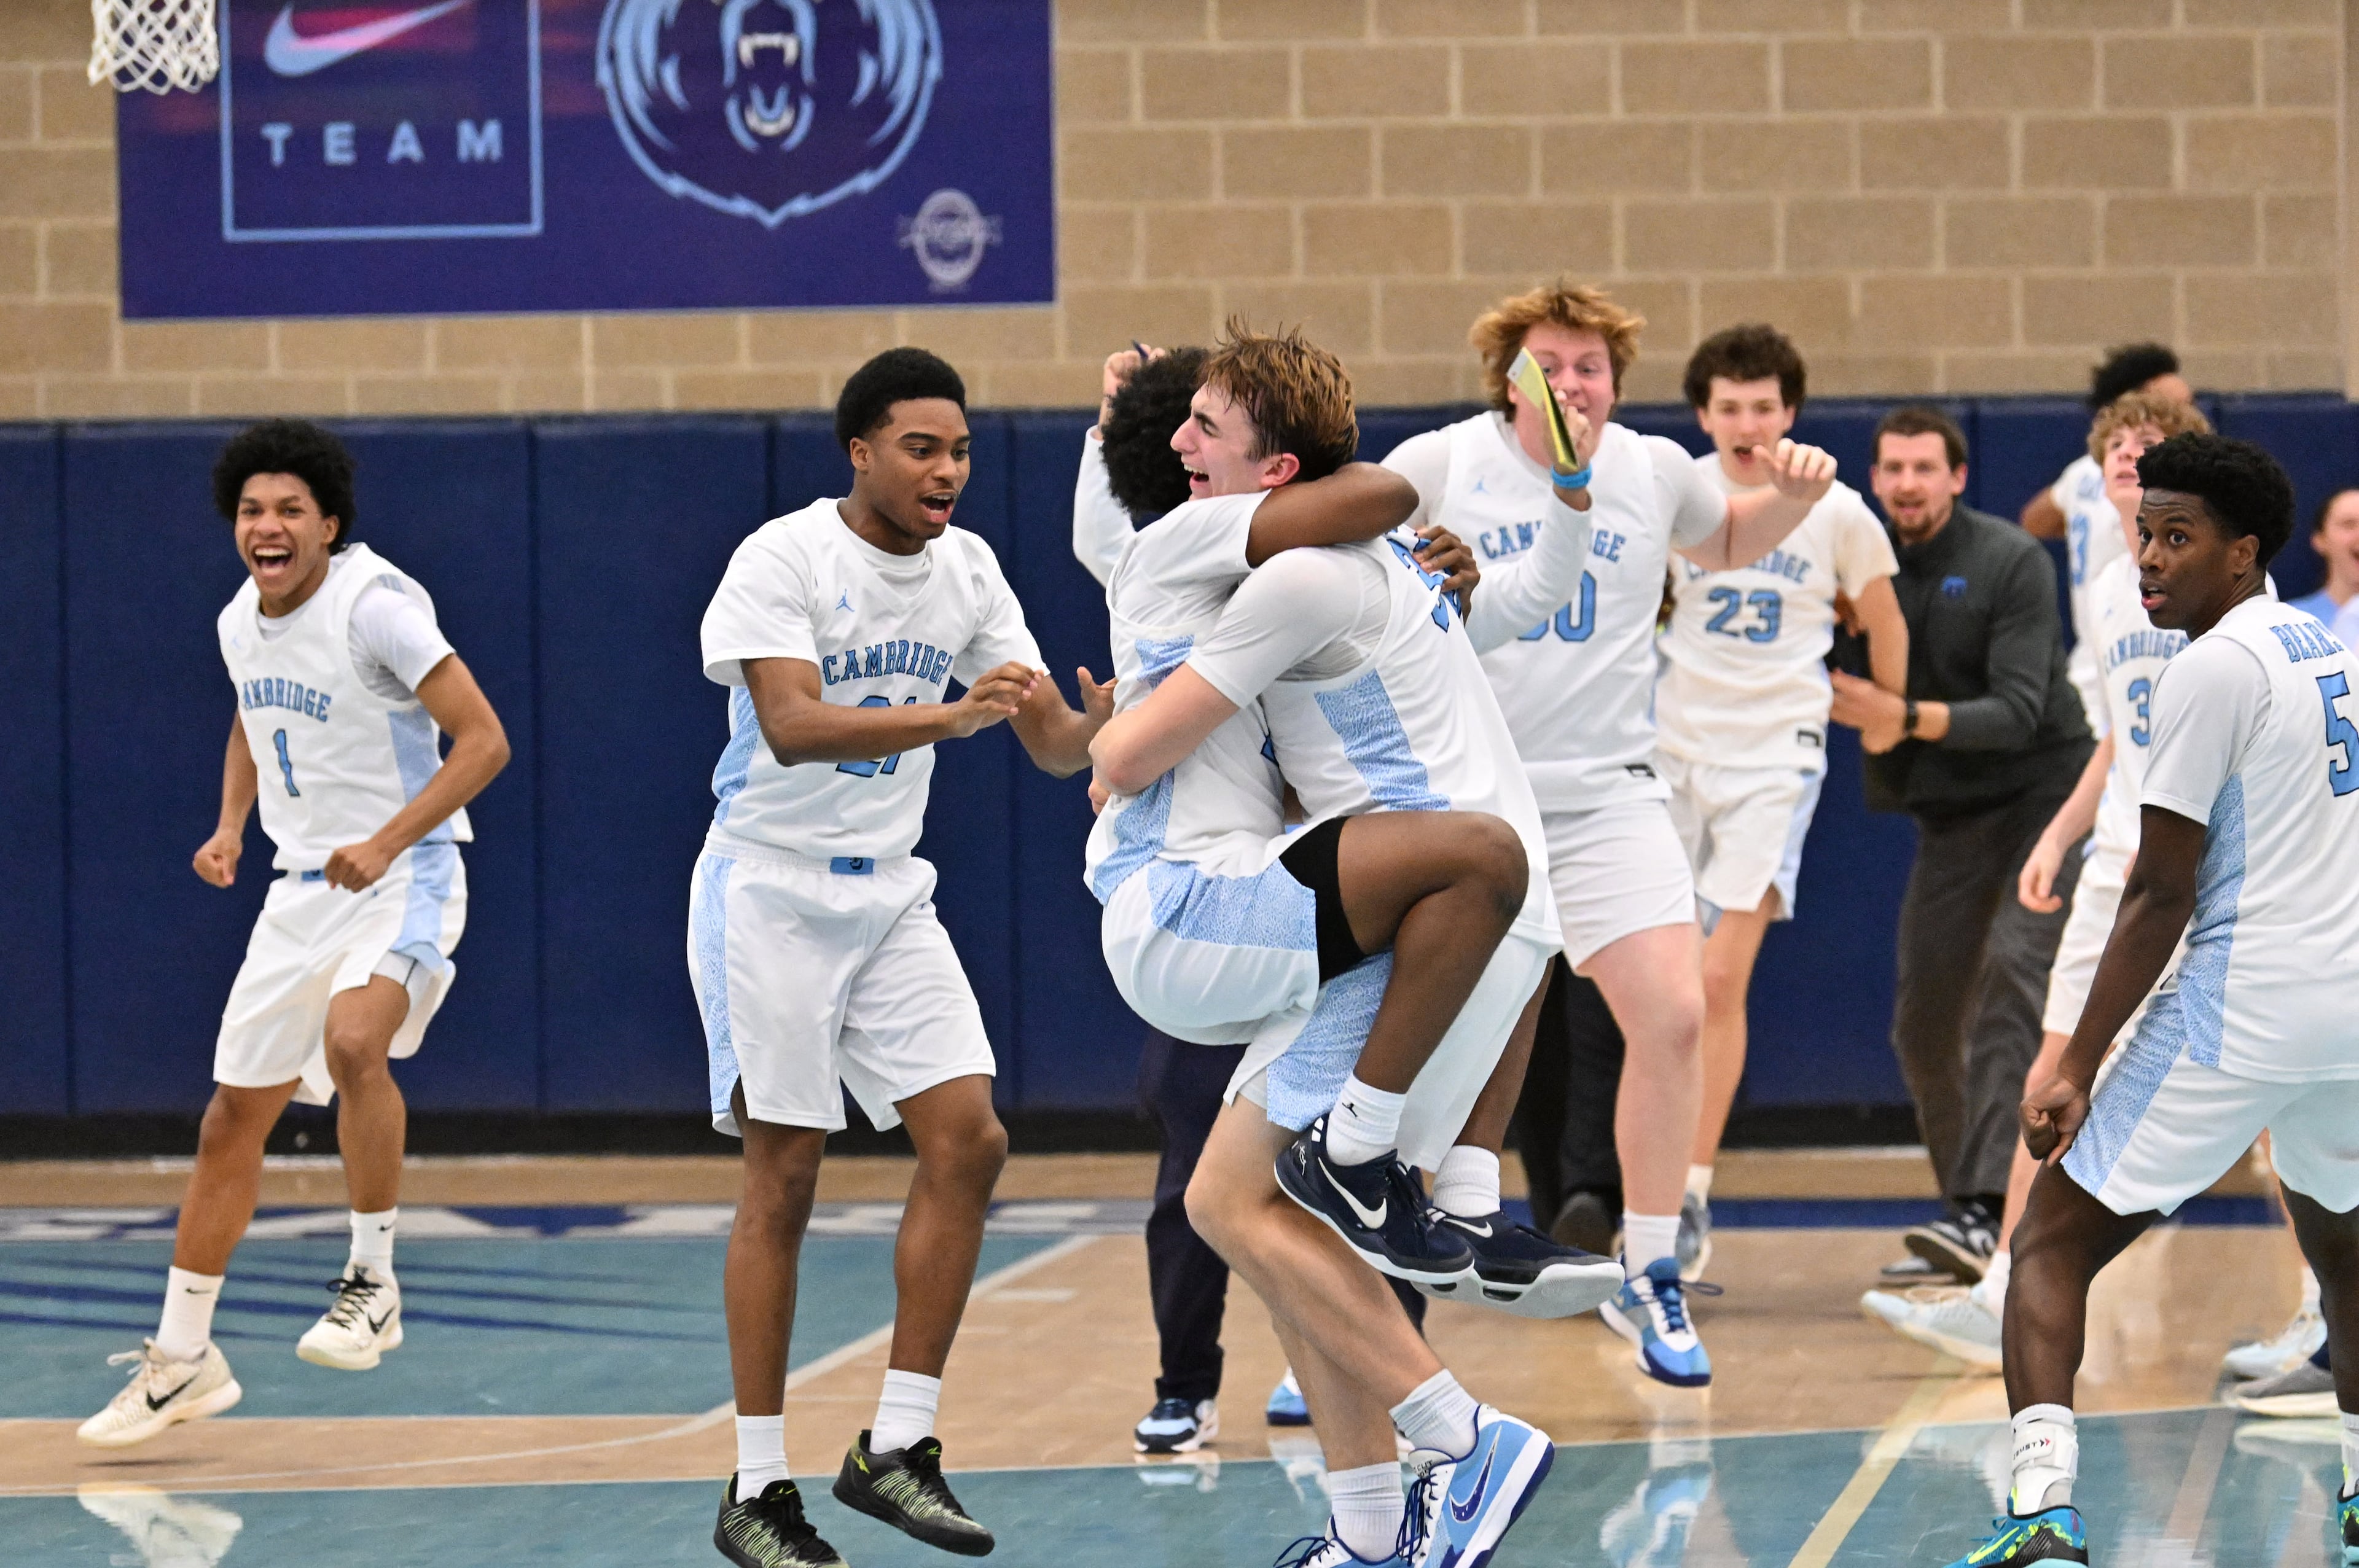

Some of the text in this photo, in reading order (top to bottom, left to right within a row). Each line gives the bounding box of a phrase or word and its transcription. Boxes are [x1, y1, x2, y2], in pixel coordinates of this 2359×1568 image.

[259, 119, 504, 168] TEAM
[1479, 520, 1627, 563] CAMGE
[1705, 585, 1783, 643] 23
[823, 639, 953, 687] CAMBRIDGE
[242, 677, 332, 723] AMBRIDGE
[2315, 670, 2359, 798] 5
[272, 728, 300, 798] 1
